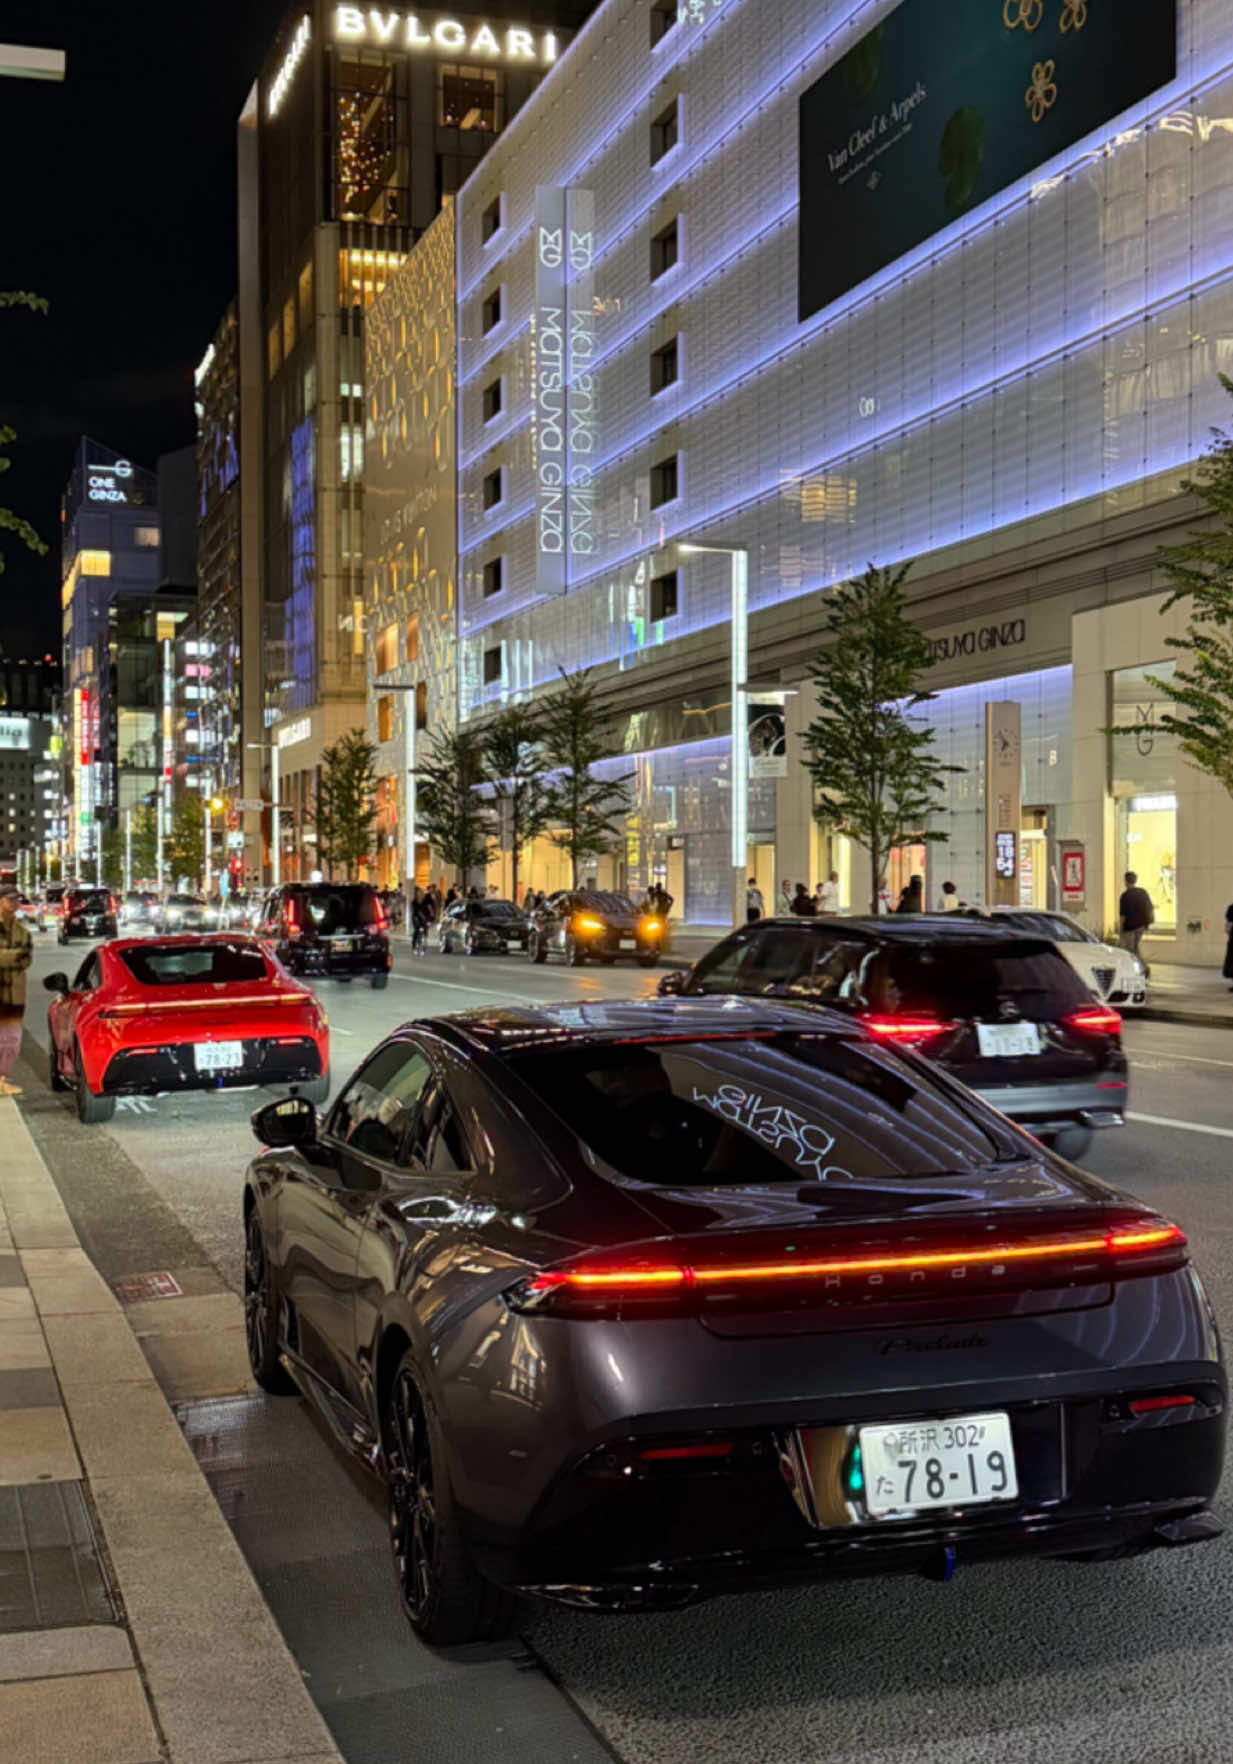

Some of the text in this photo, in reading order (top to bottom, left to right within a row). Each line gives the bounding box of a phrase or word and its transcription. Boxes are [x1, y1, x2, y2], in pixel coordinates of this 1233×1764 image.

[336, 6, 557, 63] BVLGARI
[88, 489, 128, 503] GINZA
[900, 1425, 980, 1454] 所沢 302
[876, 1450, 1009, 1503] た 78-19
